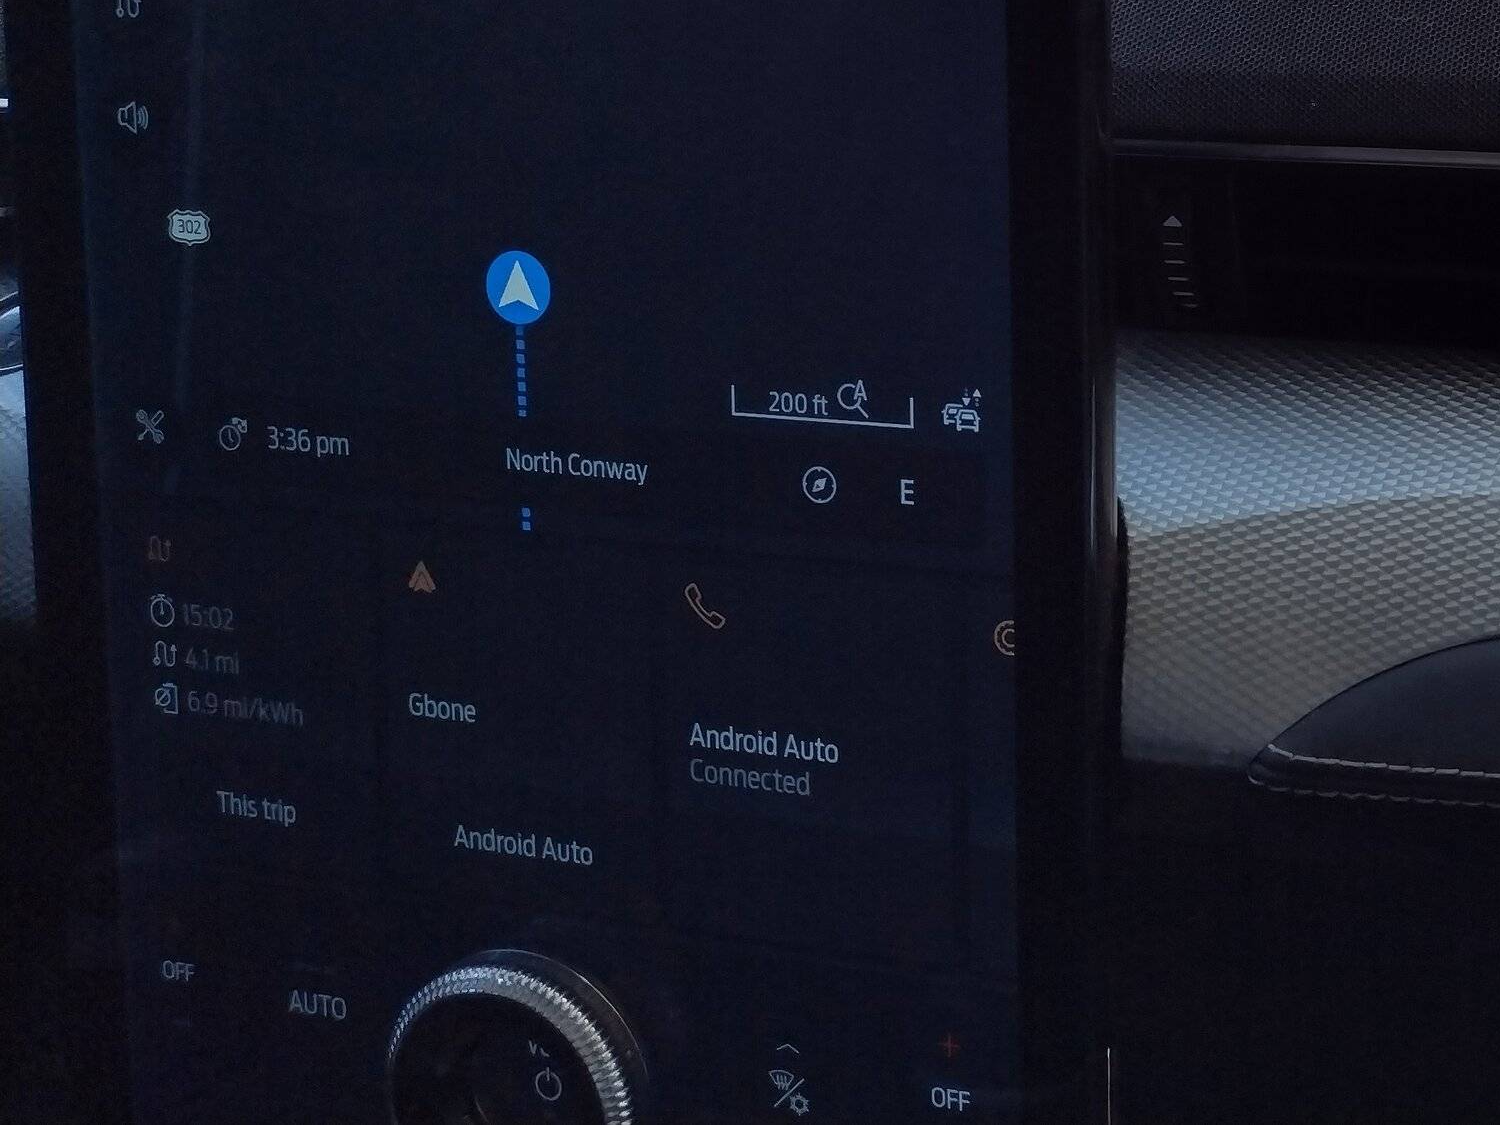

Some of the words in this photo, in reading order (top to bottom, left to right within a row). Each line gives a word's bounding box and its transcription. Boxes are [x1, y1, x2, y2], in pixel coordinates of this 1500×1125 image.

[176, 218, 202, 235] 302
[768, 391, 808, 415] 200
[811, 394, 828, 416] ft
[267, 426, 311, 453] 3:36
[316, 431, 350, 457] pm
[505, 447, 562, 475] North
[568, 452, 648, 486] Conway
[900, 479, 915, 505] E
[214, 650, 240, 676] mi
[223, 696, 304, 726] mi/kWh
[408, 692, 477, 724] Gbone
[689, 721, 778, 758] Android
[784, 733, 839, 764] Auto
[690, 757, 811, 797] Connected
[216, 790, 258, 819] This
[262, 796, 297, 827] trip
[454, 823, 537, 859] Android
[542, 834, 594, 866] Auto
[162, 960, 195, 982] OFF
[288, 990, 348, 1021] AUTO
[931, 1086, 971, 1111] OFF
